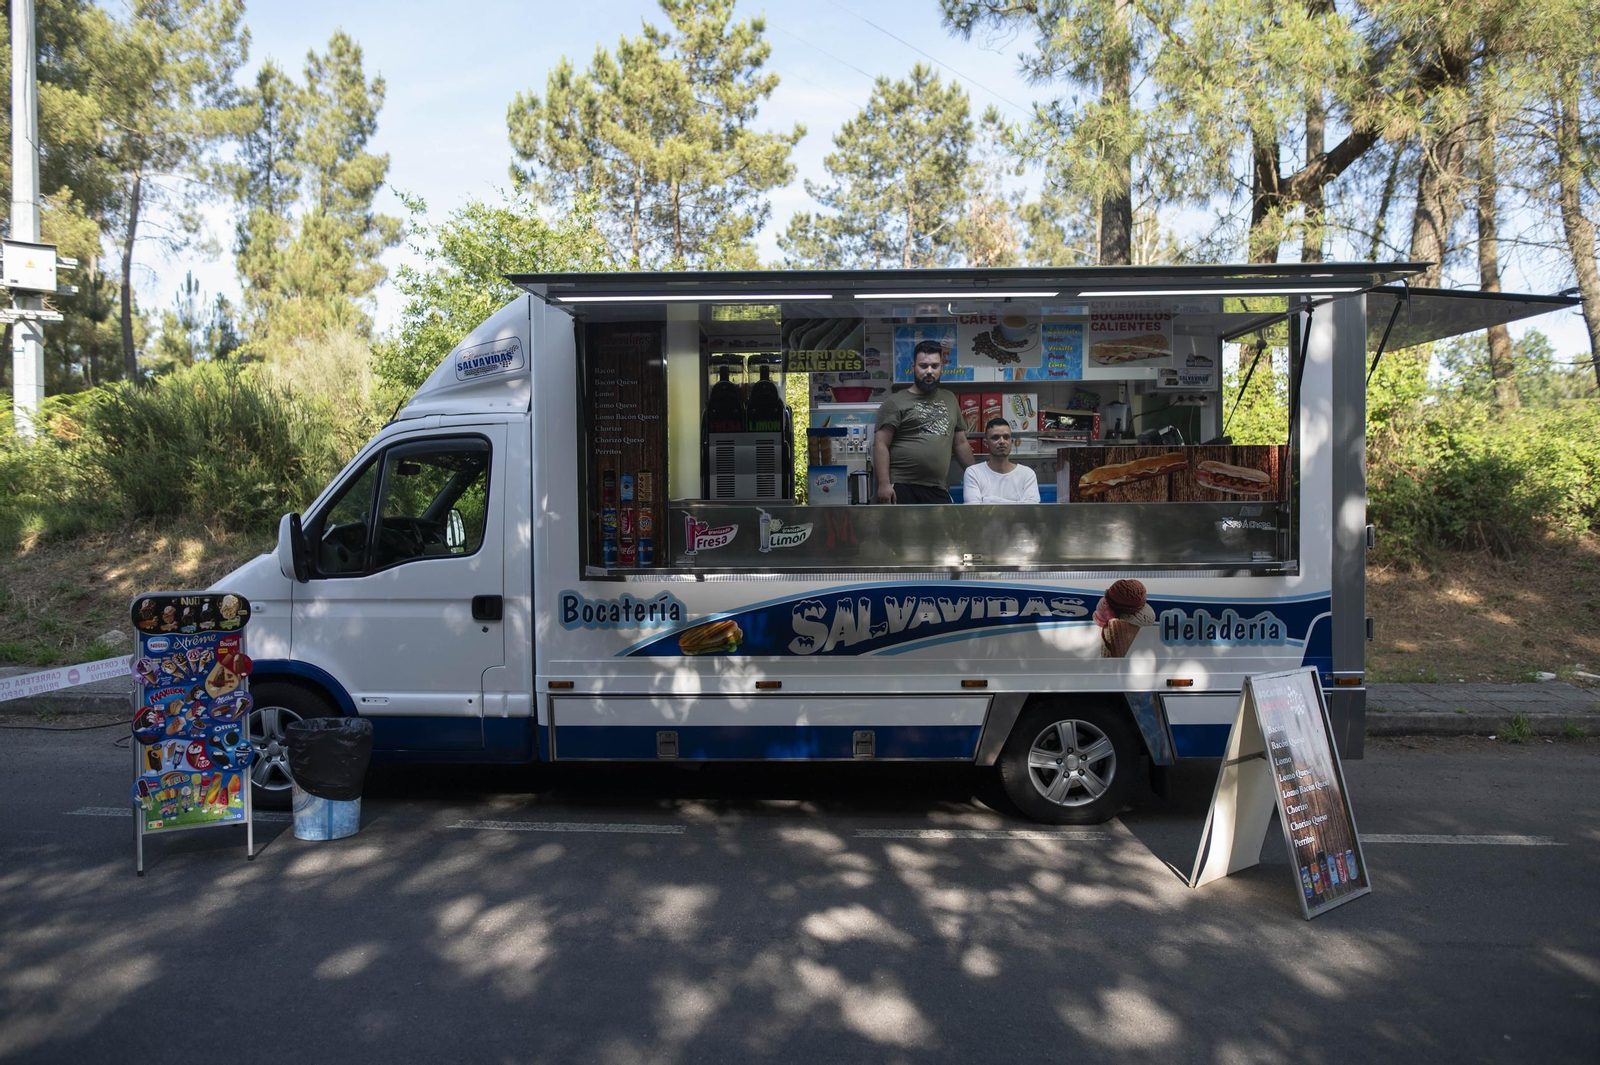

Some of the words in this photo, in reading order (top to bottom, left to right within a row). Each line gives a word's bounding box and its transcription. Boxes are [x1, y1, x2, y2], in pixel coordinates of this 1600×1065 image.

[1090, 310, 1172, 321] BOCADILLOS
[1090, 322, 1162, 332] CALIENTES
[788, 349, 856, 360] PERRITOS
[457, 352, 513, 372] SALVAVIDAS
[787, 360, 862, 370] CALIENTES
[616, 379, 638, 387] Queso
[615, 402, 637, 410] Queso
[637, 413, 660, 421] Queso
[623, 436, 645, 444] Queso
[696, 535, 728, 549] Fresa
[562, 594, 681, 624] Bocatería
[788, 596, 1090, 655] SALVAVIDAS
[1163, 613, 1280, 641] Heladería
[1274, 756, 1292, 766] Lomo
[1278, 772, 1296, 782] Lomo
[1295, 767, 1312, 779] Queso
[1282, 788, 1300, 799] Lomo
[1314, 780, 1330, 790] Queso
[1286, 803, 1309, 815] Chorizo
[1290, 819, 1312, 831] Chorizo
[1311, 814, 1328, 825] Queso
[1294, 836, 1315, 848] Perritos
